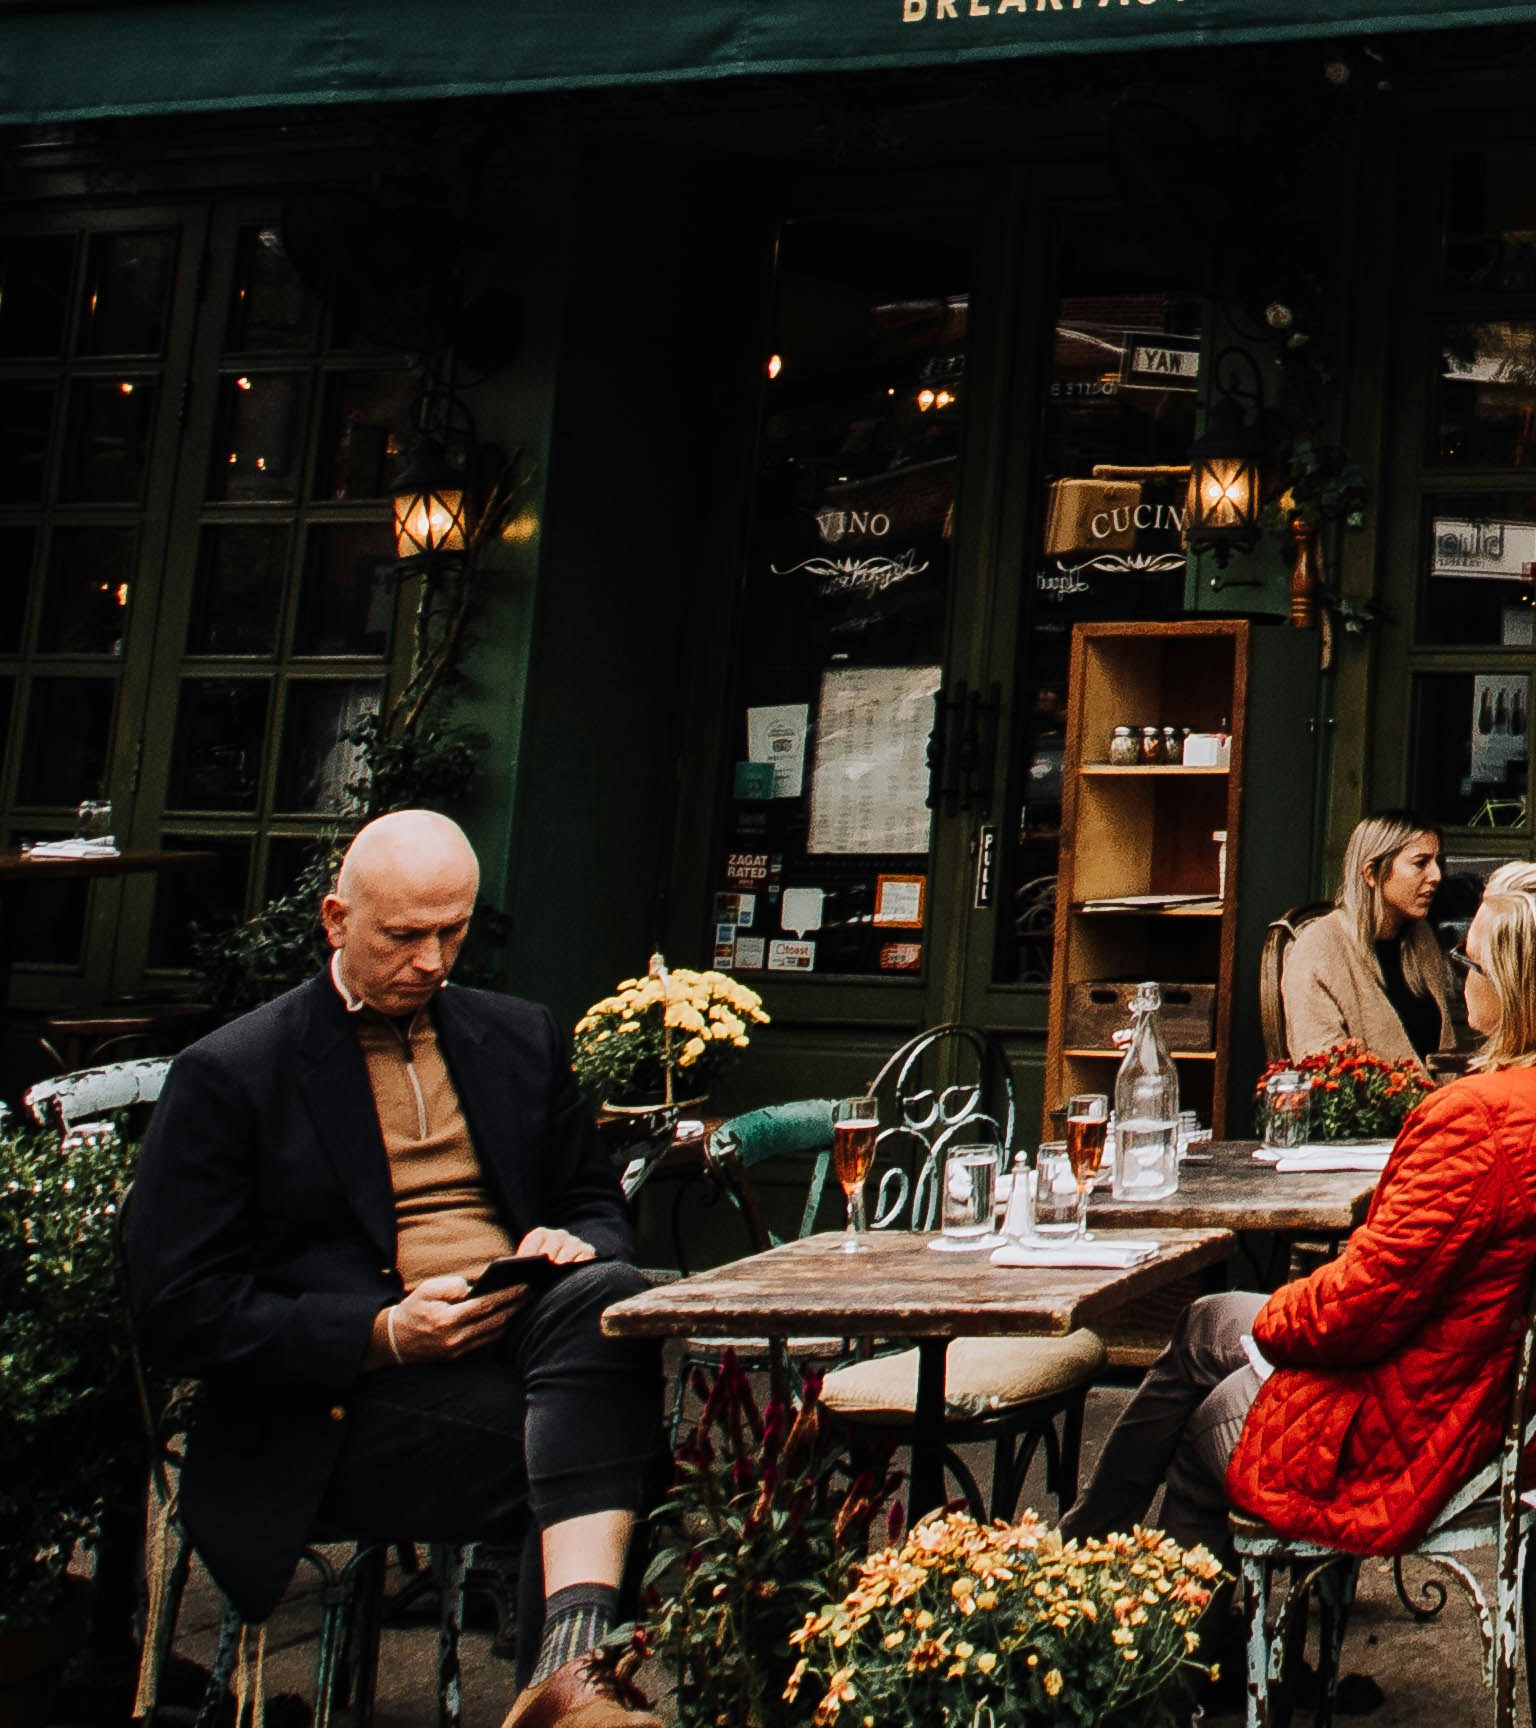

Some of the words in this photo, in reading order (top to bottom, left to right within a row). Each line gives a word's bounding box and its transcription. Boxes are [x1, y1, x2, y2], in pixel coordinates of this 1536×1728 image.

[816, 511, 890, 536] VINO
[1091, 504, 1187, 539] CUCIN
[728, 854, 768, 866] ZAGAT
[981, 833, 993, 900] PULL
[727, 867, 767, 879] RATED
